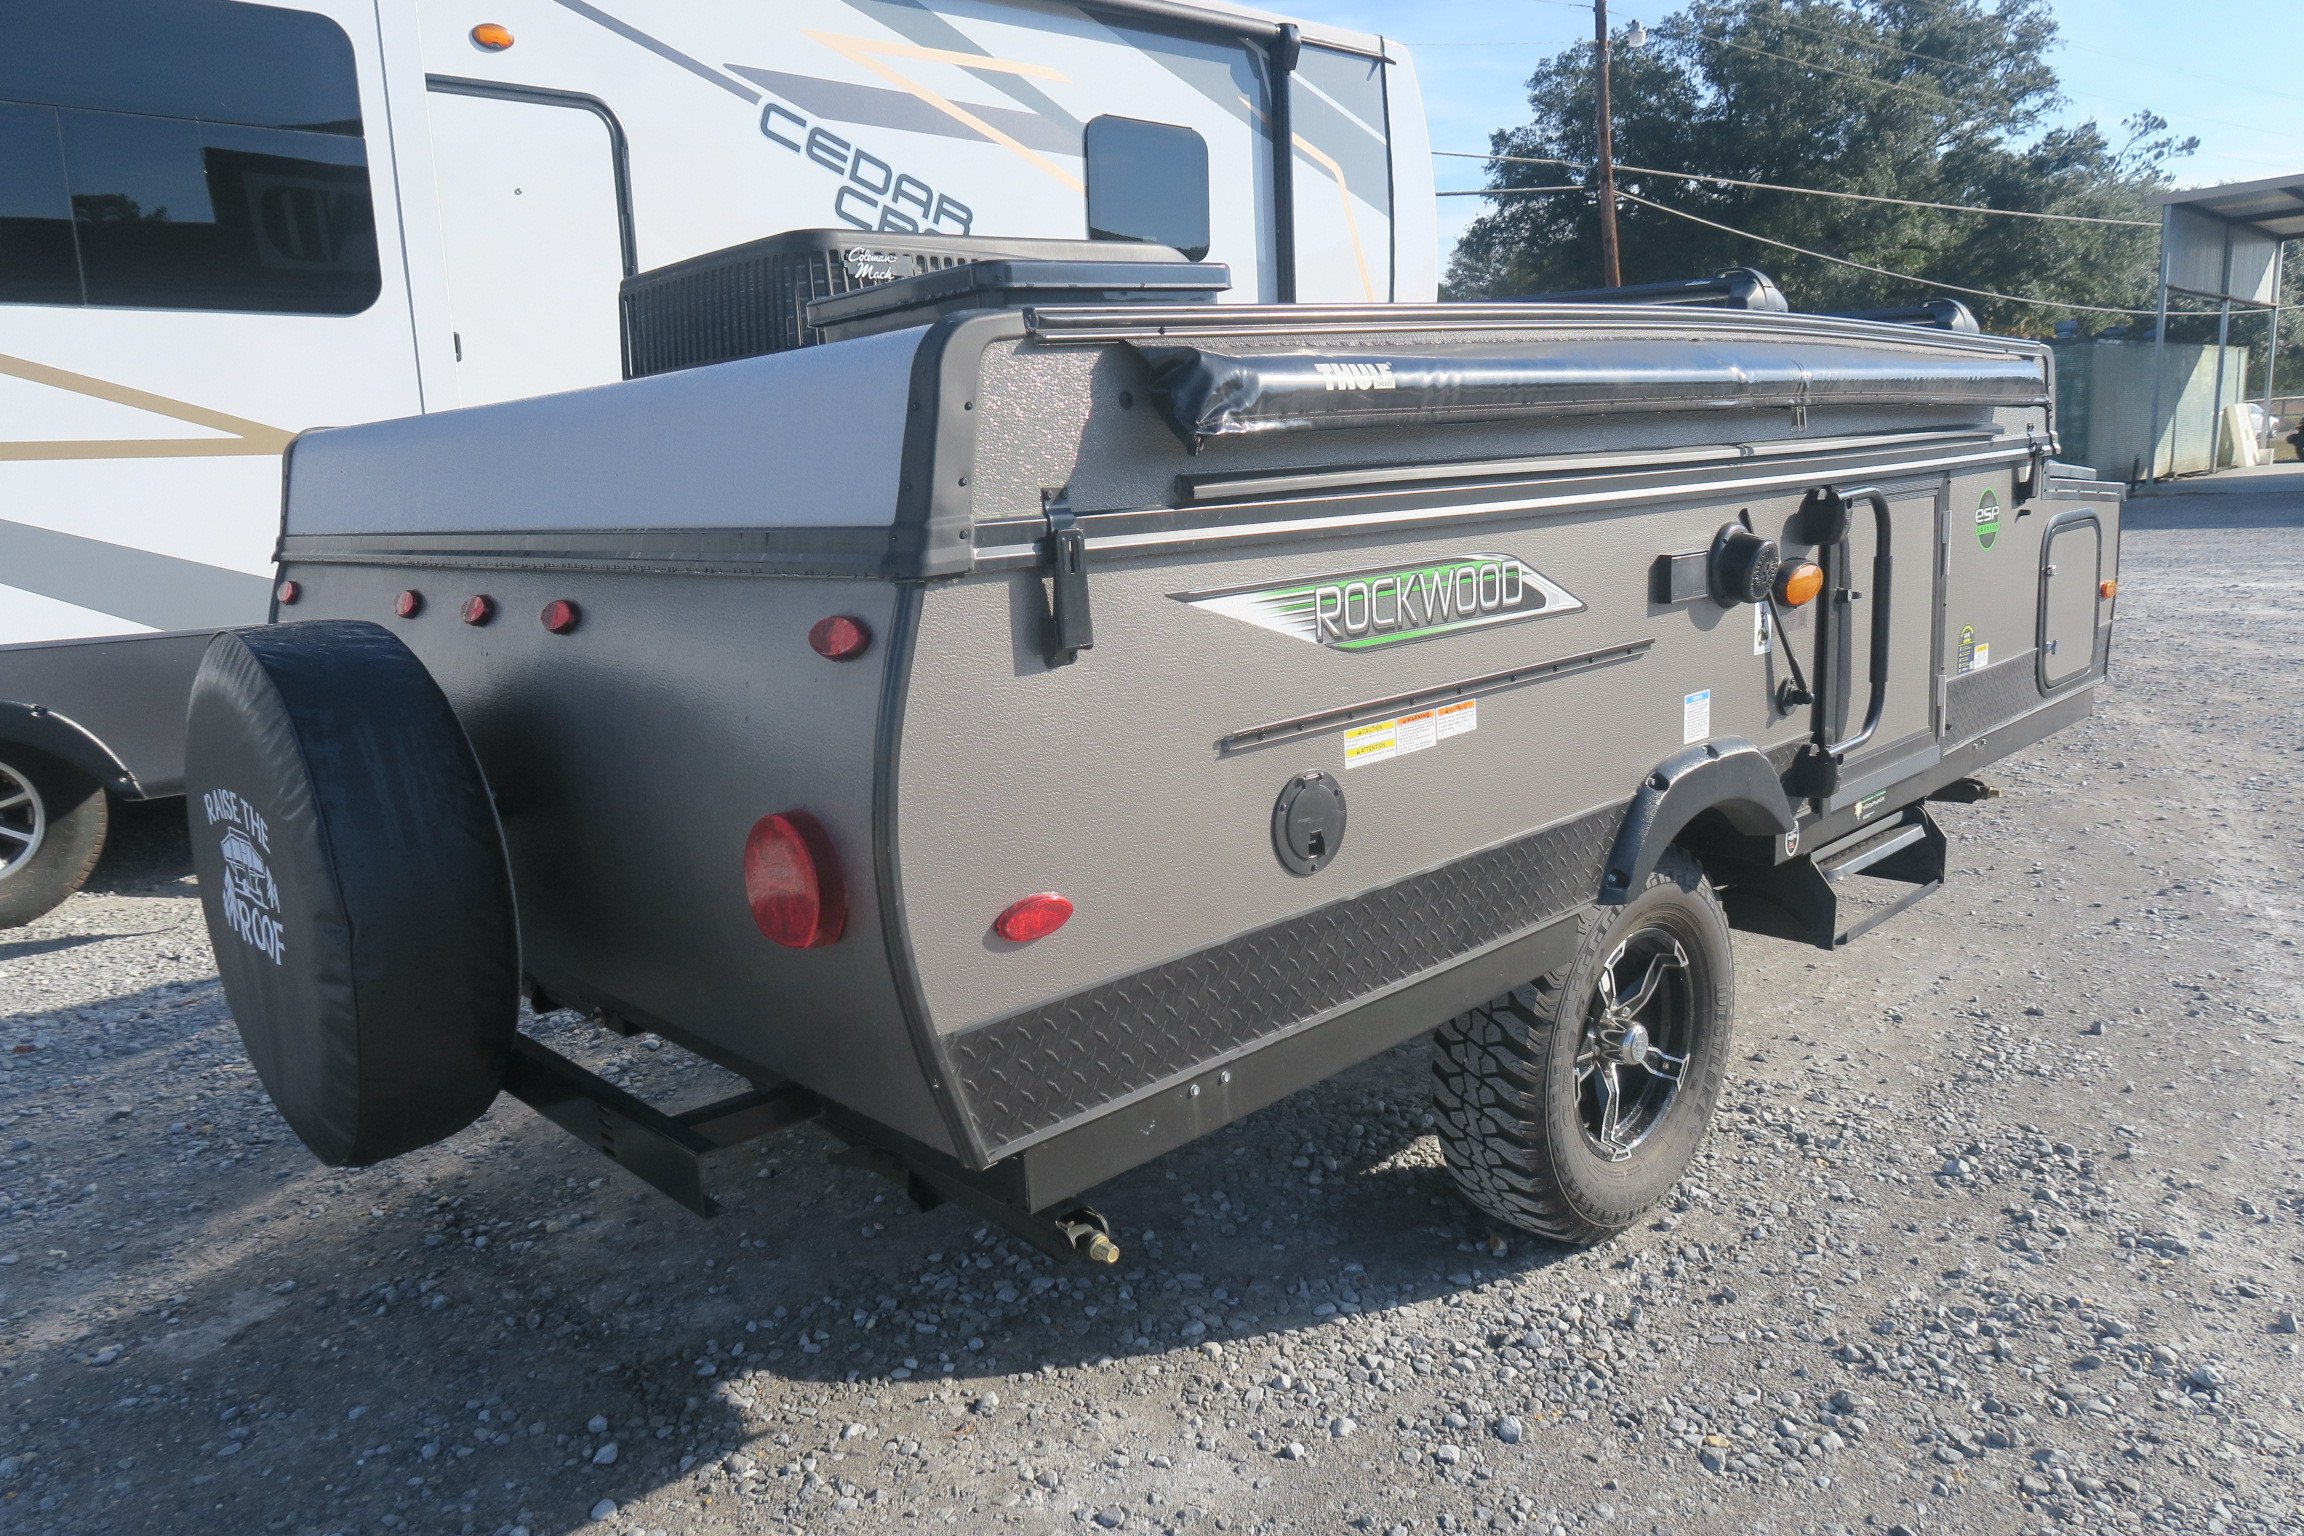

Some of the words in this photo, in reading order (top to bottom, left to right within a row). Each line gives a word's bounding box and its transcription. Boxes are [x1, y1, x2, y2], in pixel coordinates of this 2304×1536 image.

[760, 103, 973, 237] CEDAR
[848, 247, 895, 263] Coleman
[855, 263, 894, 279] Mach
[1314, 362, 1394, 390] THULE
[1315, 560, 1523, 643] ROCKWOOD
[1362, 724, 1383, 735] CAUTION
[1360, 741, 1386, 754] ATTENTION
[204, 788, 242, 825] RAISE
[240, 798, 272, 855] THE
[237, 898, 286, 966] ROOF
